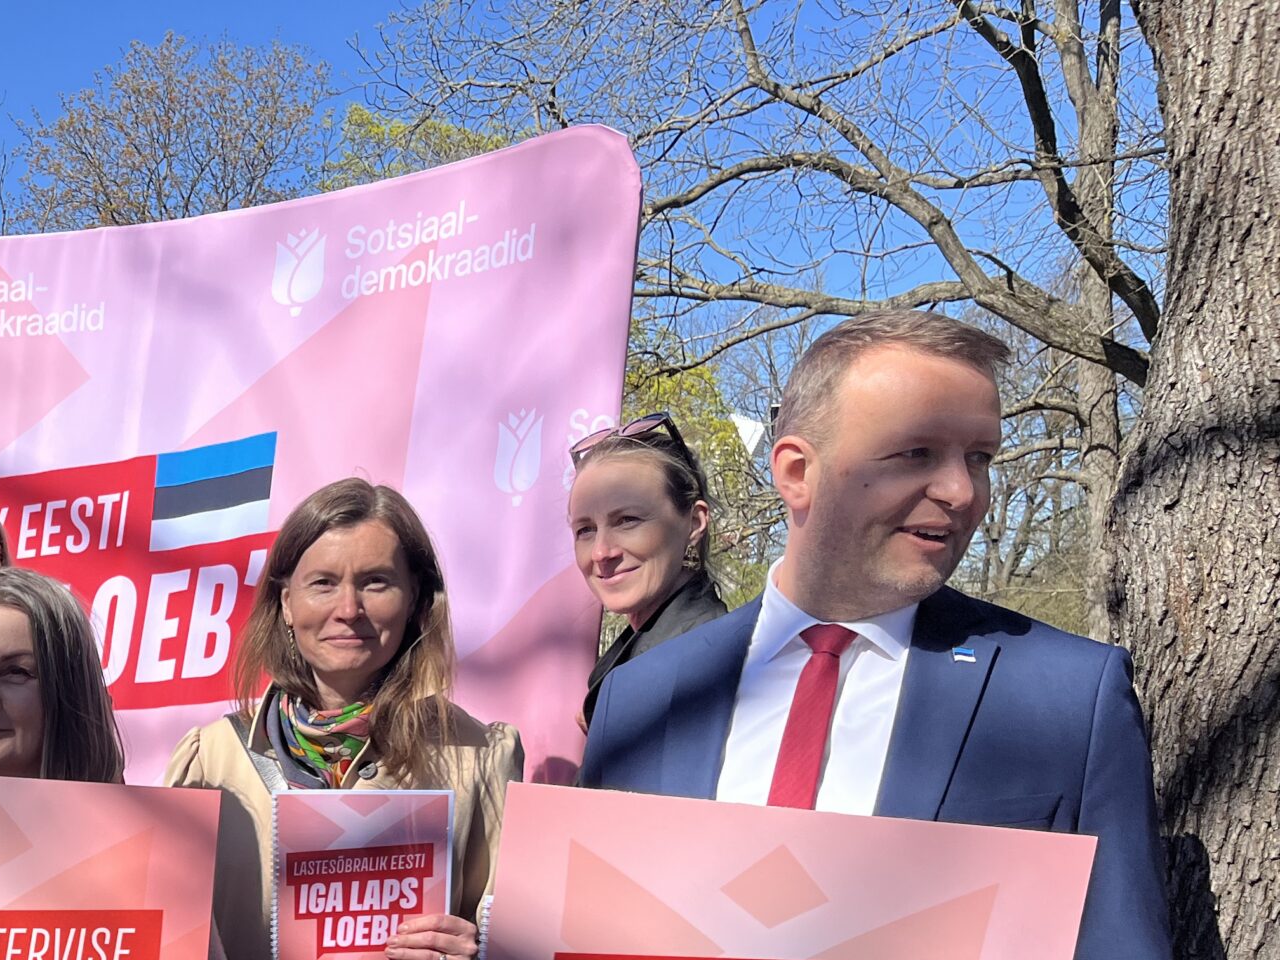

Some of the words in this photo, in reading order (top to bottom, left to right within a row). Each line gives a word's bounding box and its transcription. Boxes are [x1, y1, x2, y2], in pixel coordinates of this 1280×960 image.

[344, 200, 479, 260] Sotsiaal-
[340, 223, 536, 300] demokraadid
[17, 490, 130, 560] EESTI
[293, 855, 387, 876] LASTESÕBRALIK
[390, 853, 426, 870] EESTI
[298, 881, 344, 914] IGA
[349, 877, 418, 912] LAPS
